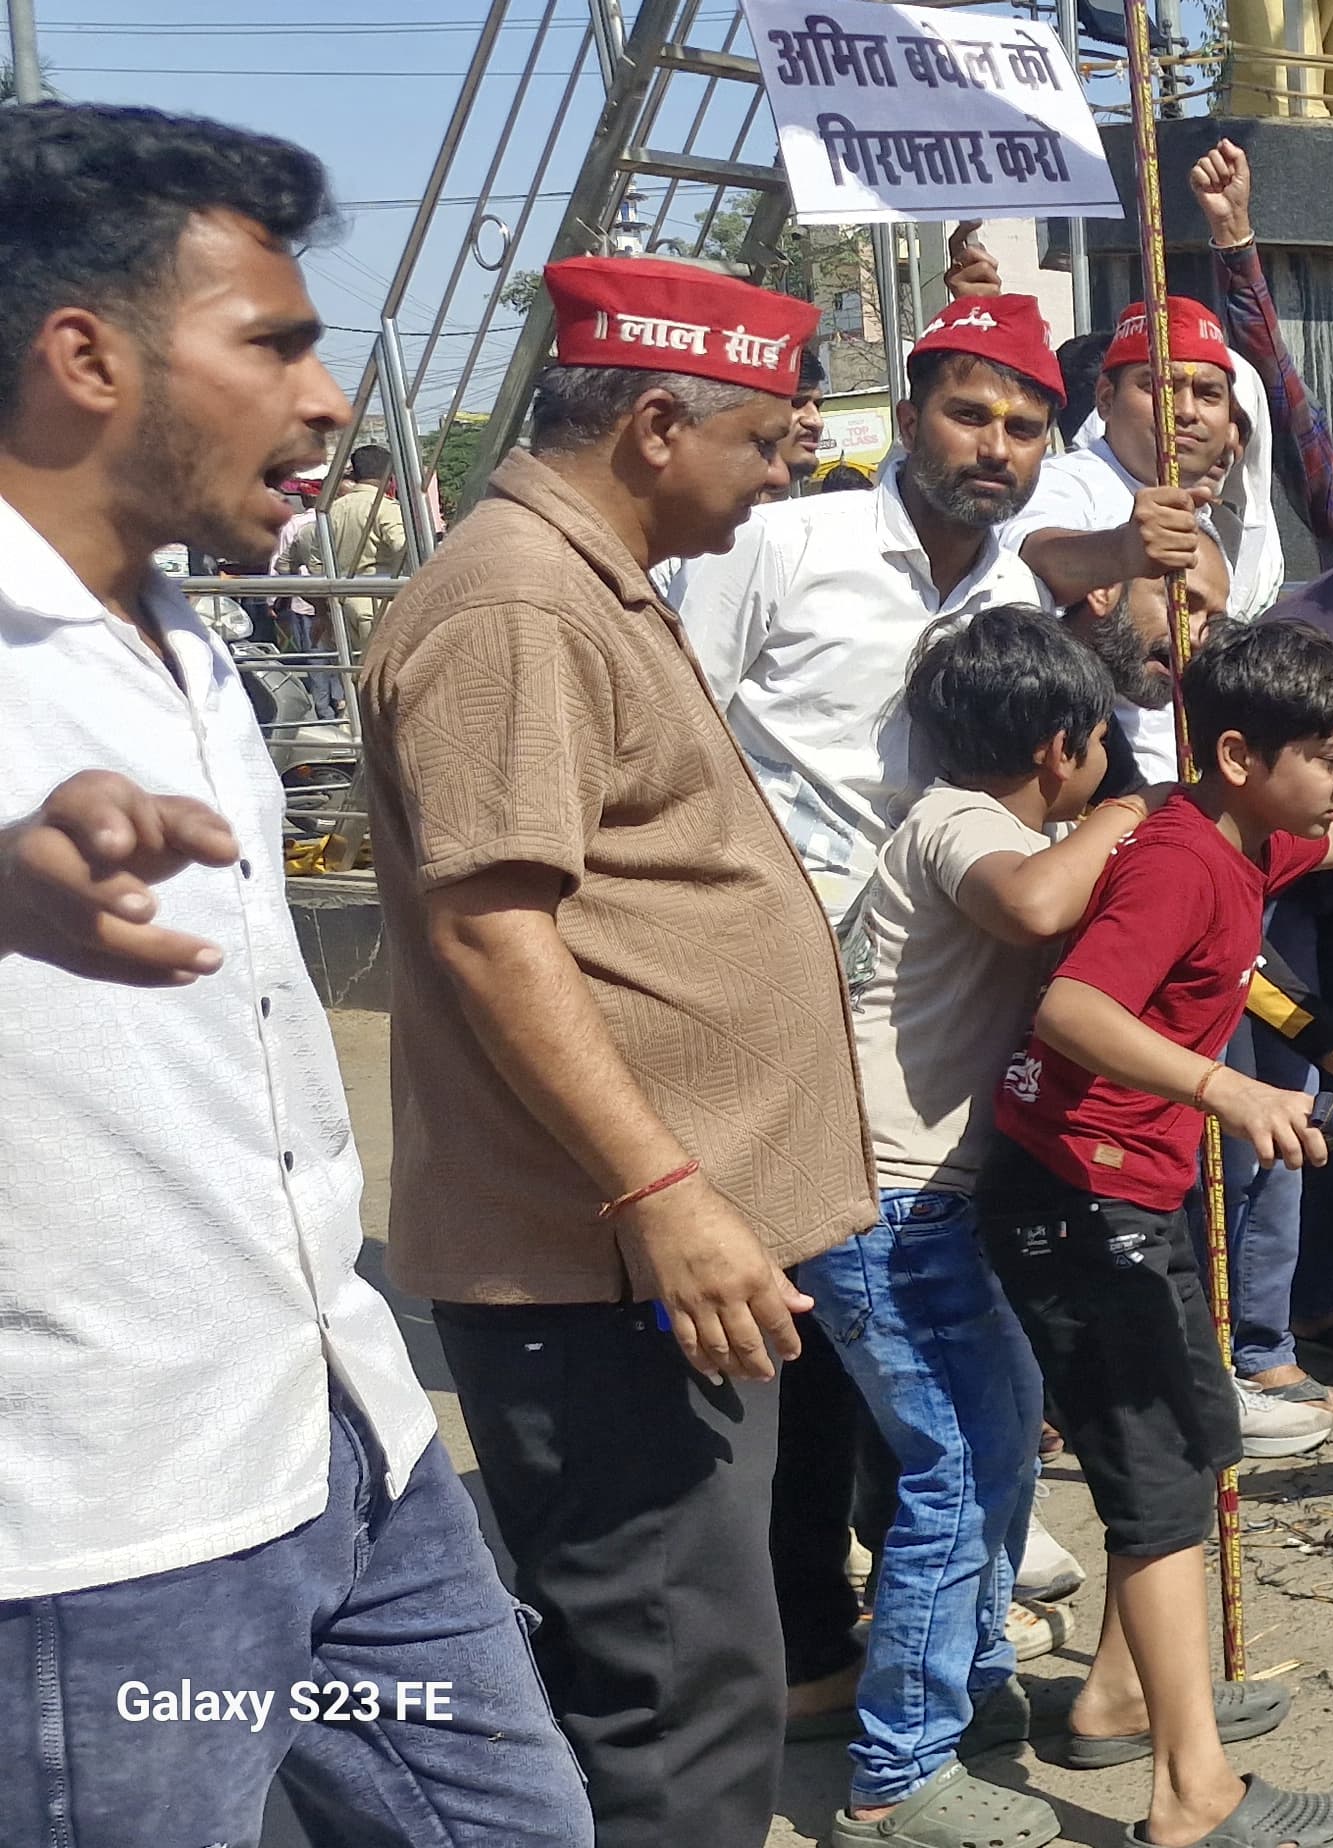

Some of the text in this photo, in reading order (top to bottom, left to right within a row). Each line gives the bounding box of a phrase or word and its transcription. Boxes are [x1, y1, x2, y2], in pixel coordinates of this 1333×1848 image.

[767, 15, 1062, 91] अमित बघेल को
[816, 112, 1071, 186] गिरफ्तार करो
[616, 313, 711, 356] लाल
[842, 434, 879, 447] CLASS
[847, 425, 869, 436] TOP
